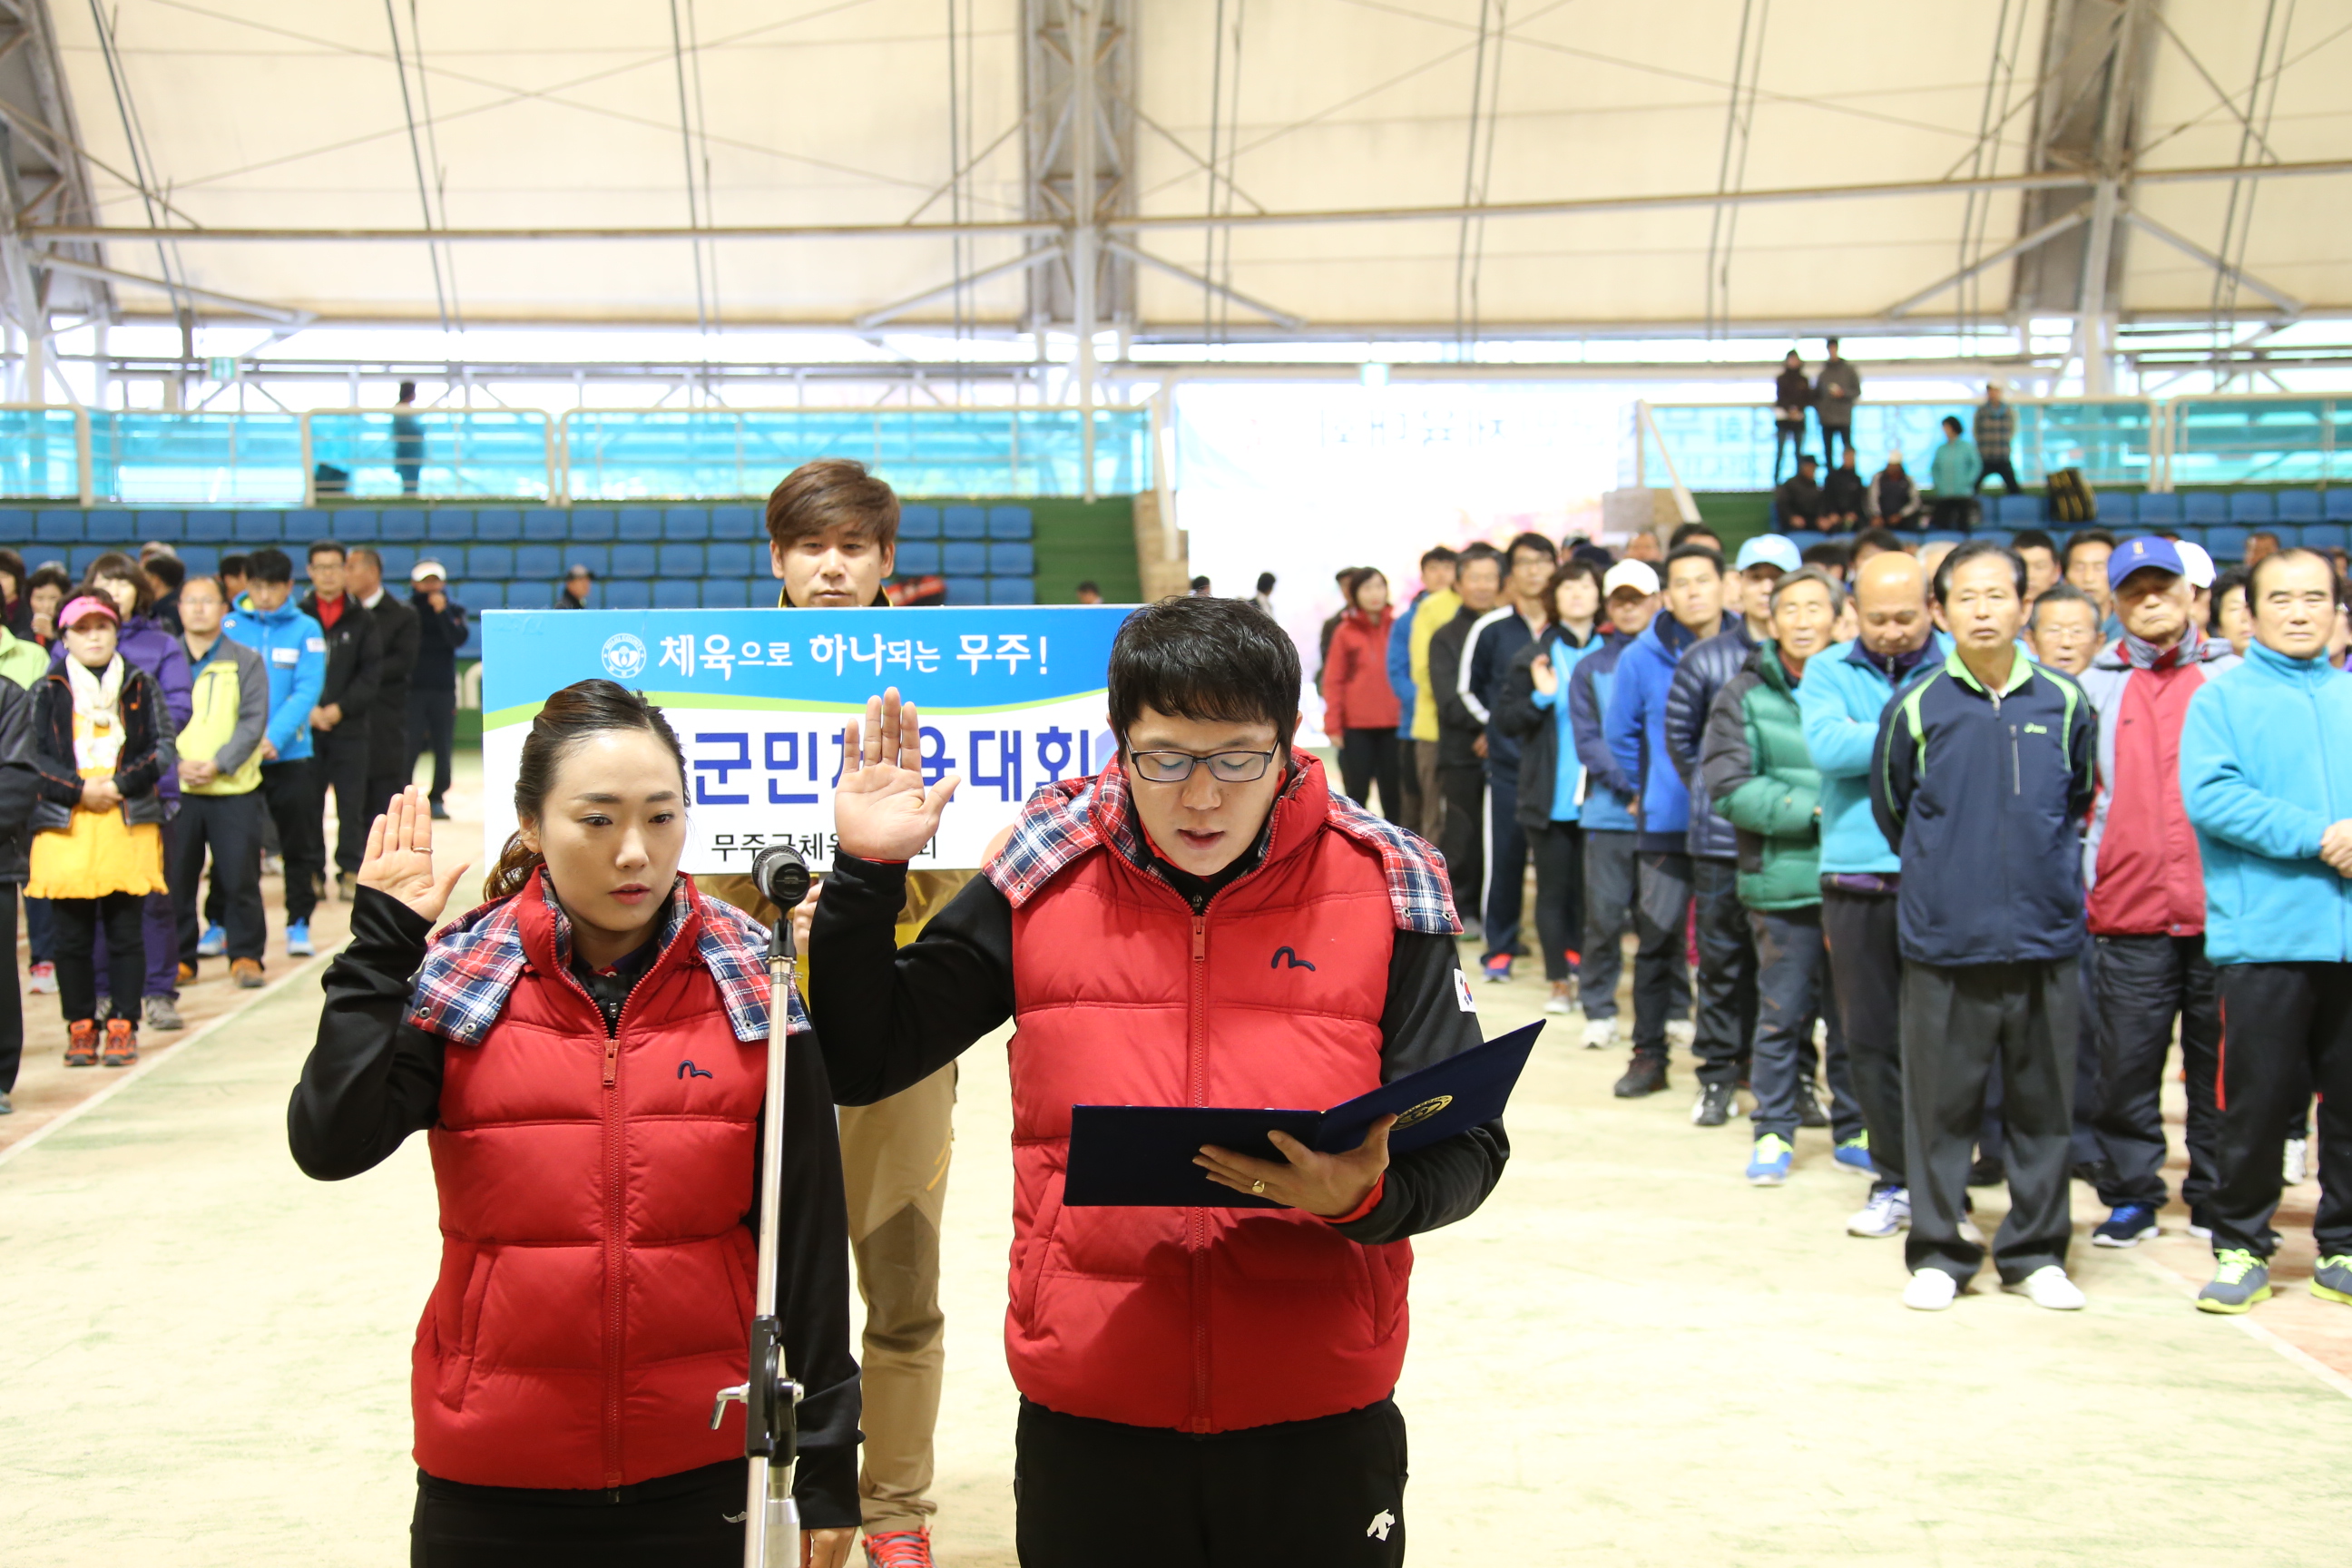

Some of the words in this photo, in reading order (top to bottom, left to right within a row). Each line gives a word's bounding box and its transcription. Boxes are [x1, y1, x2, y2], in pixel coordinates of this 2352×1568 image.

[658, 634, 793, 681] 체육으로
[808, 633, 940, 677] 하나되는
[956, 634, 1047, 676] 무주!
[673, 725, 1089, 806] 군민육대회
